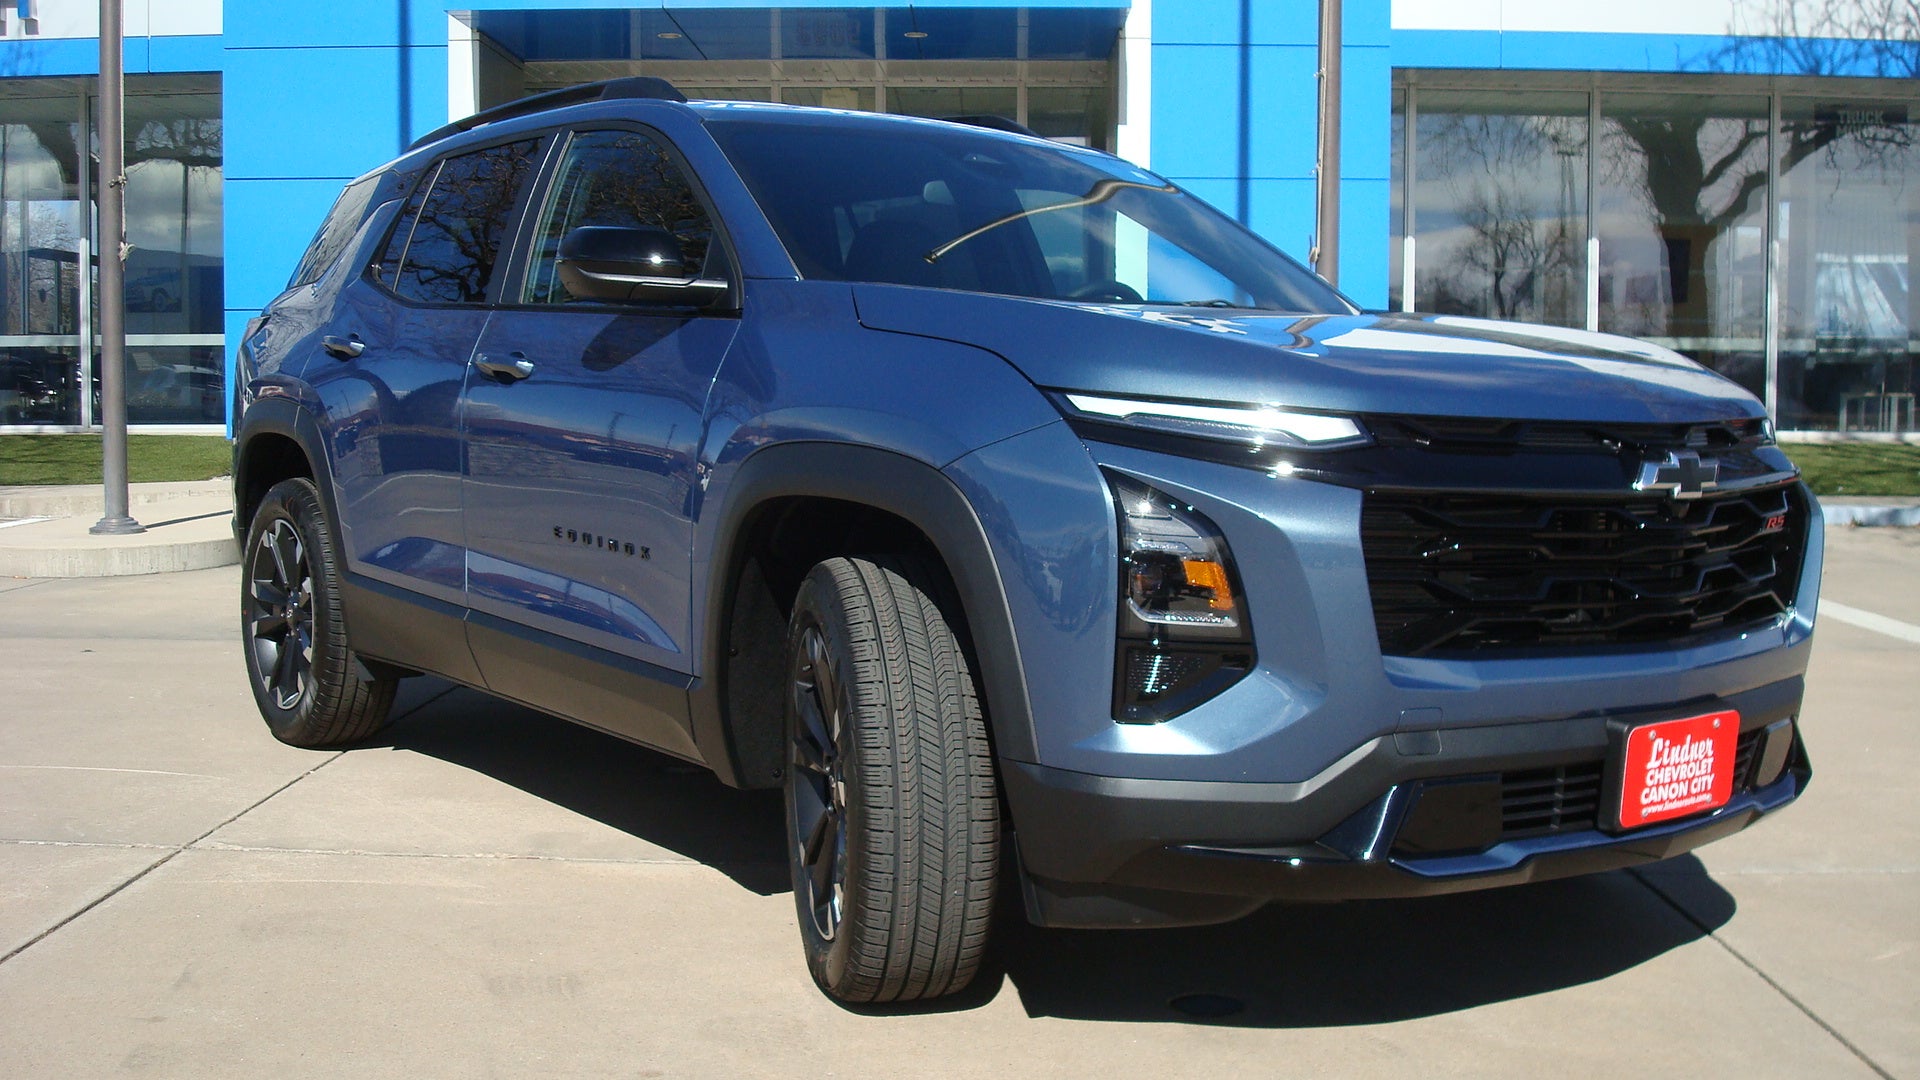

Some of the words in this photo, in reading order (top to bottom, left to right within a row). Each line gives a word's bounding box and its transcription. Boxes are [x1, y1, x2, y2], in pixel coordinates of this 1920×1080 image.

[553, 525, 651, 561] EQUINOX
[1646, 734, 1714, 769] Lindner
[1645, 757, 1714, 787] CHEVROLET
[1641, 781, 1689, 805] CANON
[1690, 774, 1715, 795] CITY
